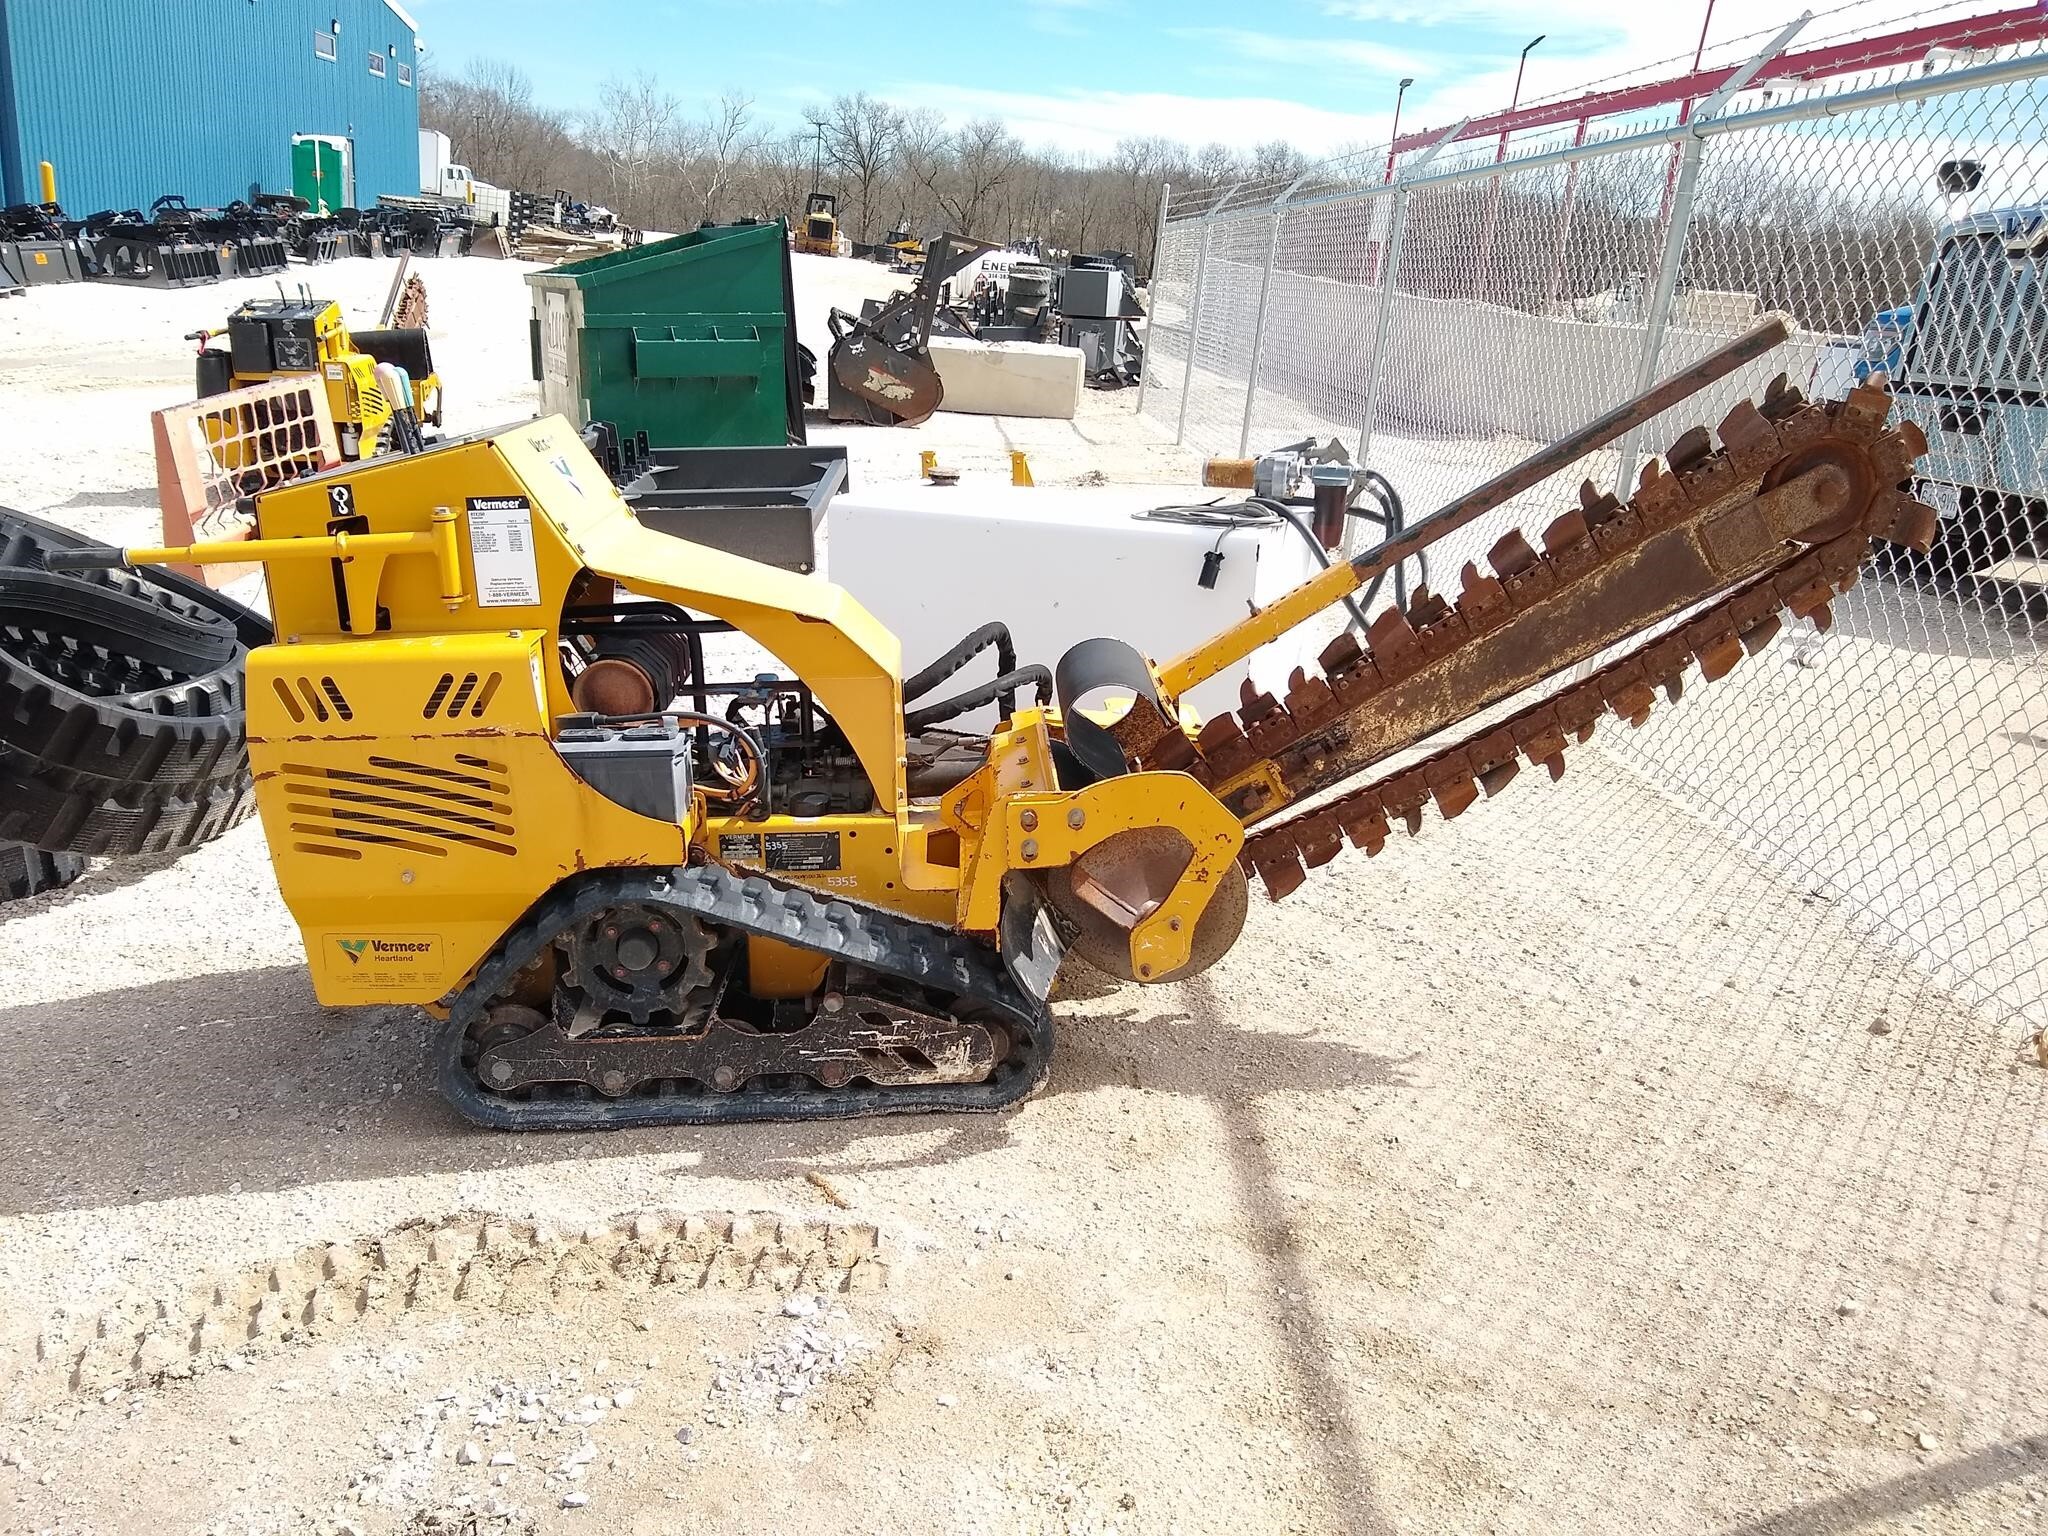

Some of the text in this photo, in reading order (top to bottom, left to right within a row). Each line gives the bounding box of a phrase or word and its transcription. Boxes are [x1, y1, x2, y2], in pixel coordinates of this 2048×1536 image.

[473, 499, 520, 510] Vermeer
[765, 841, 788, 850] 5355
[827, 875, 858, 887] 5355
[370, 940, 431, 952] Vermeer
